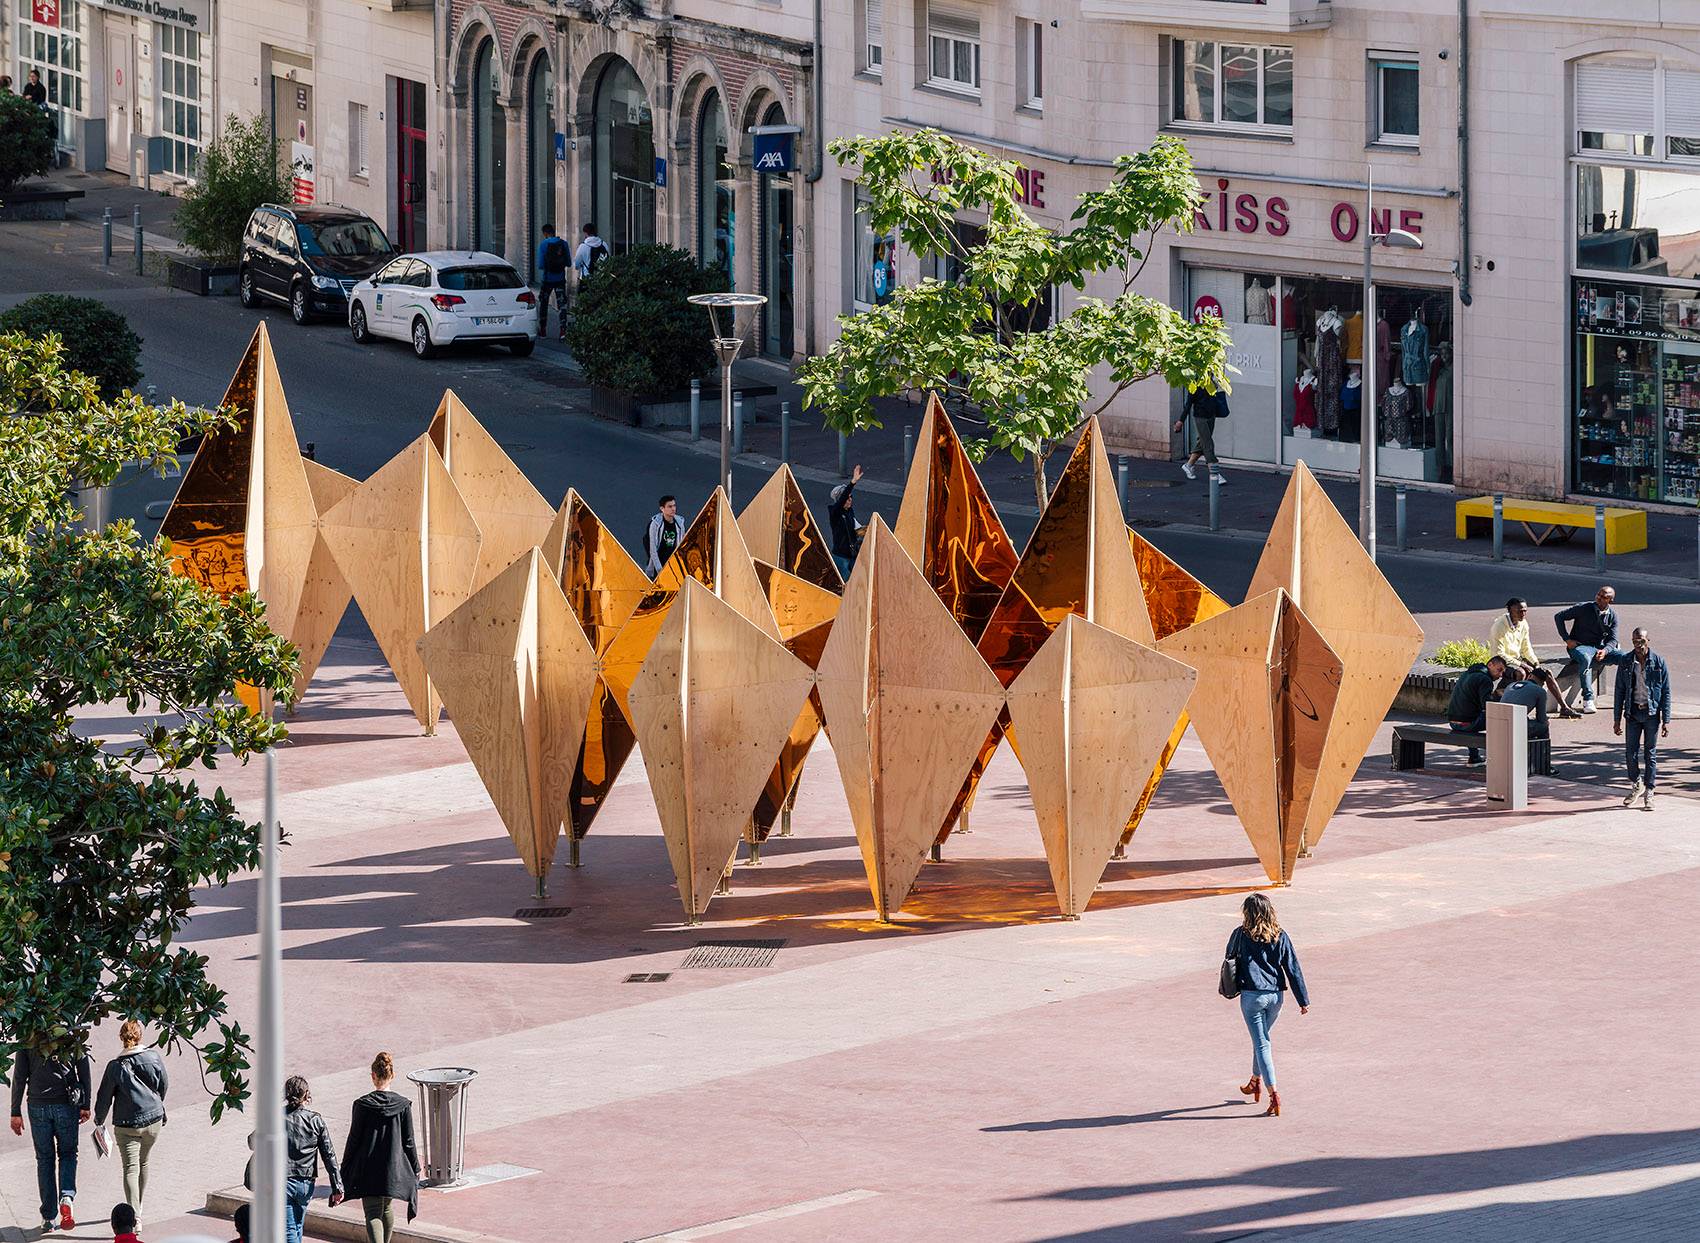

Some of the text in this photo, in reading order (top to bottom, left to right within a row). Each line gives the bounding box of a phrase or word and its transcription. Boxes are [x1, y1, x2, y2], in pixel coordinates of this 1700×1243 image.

[145, 0, 152, 14] du
[153, 2, 178, 20] Chapeau
[179, 7, 198, 27] Rouge
[756, 152, 785, 168] AXA
[1330, 202, 1424, 249] ONE
[1236, 353, 1262, 368] PRIX
